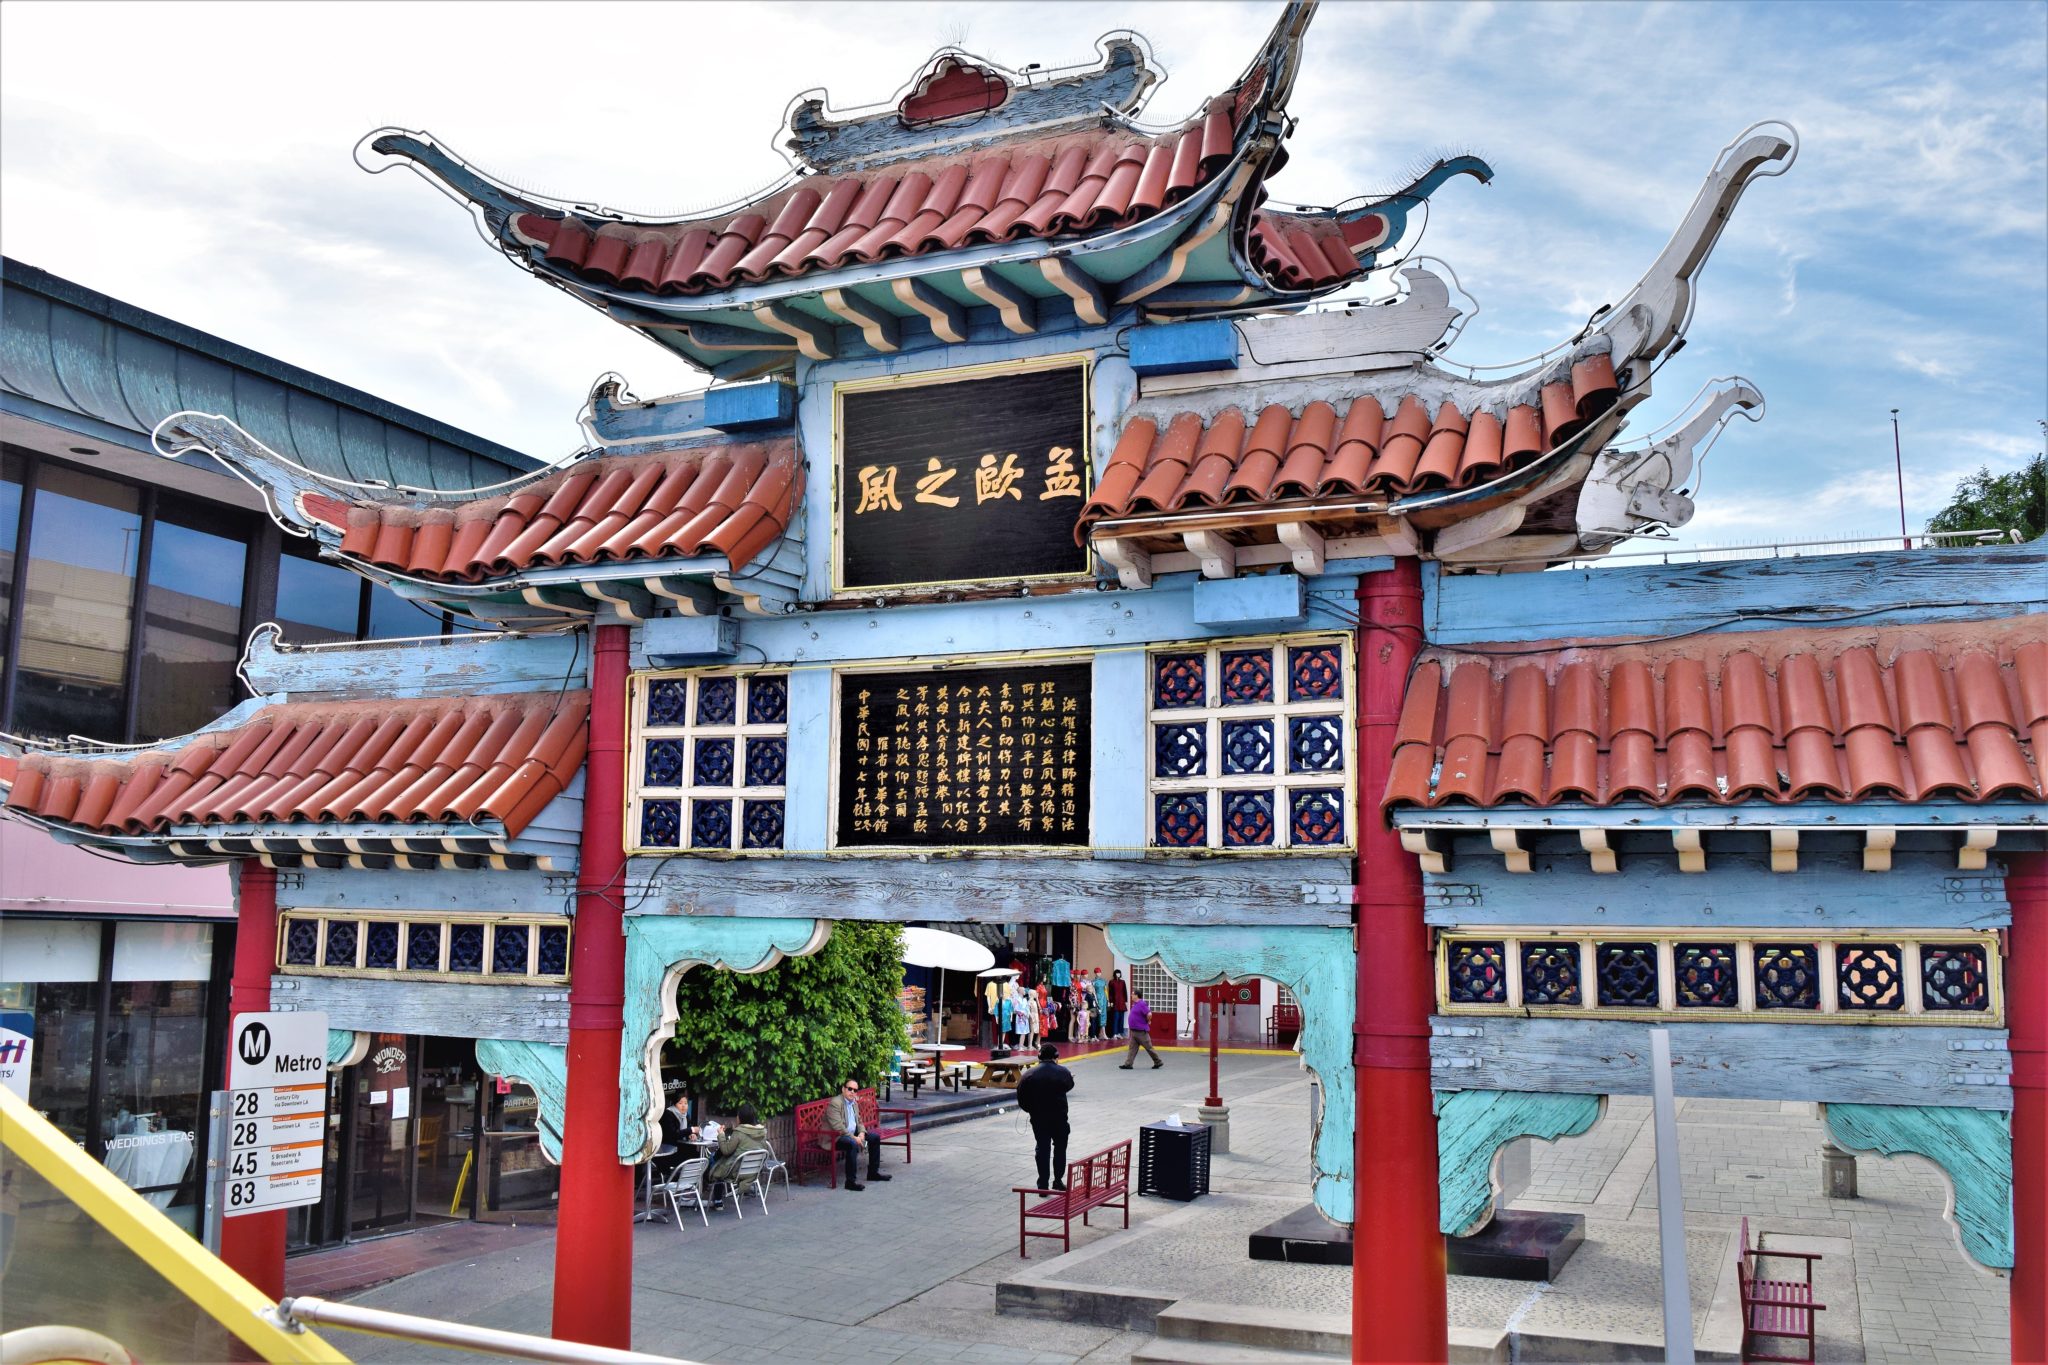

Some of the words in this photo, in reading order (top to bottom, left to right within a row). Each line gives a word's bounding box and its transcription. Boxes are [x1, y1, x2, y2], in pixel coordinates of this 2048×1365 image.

[244, 1030, 266, 1058] M
[372, 1047, 407, 1065] WONDER
[275, 1055, 322, 1074] Metro
[235, 1092, 259, 1116] 28
[504, 1099, 526, 1108] PARTY
[105, 1134, 166, 1151] WEDDINGS
[169, 1131, 195, 1145] TEAS
[233, 1122, 257, 1146] 28
[232, 1152, 258, 1176] 45
[231, 1181, 256, 1206] 83
